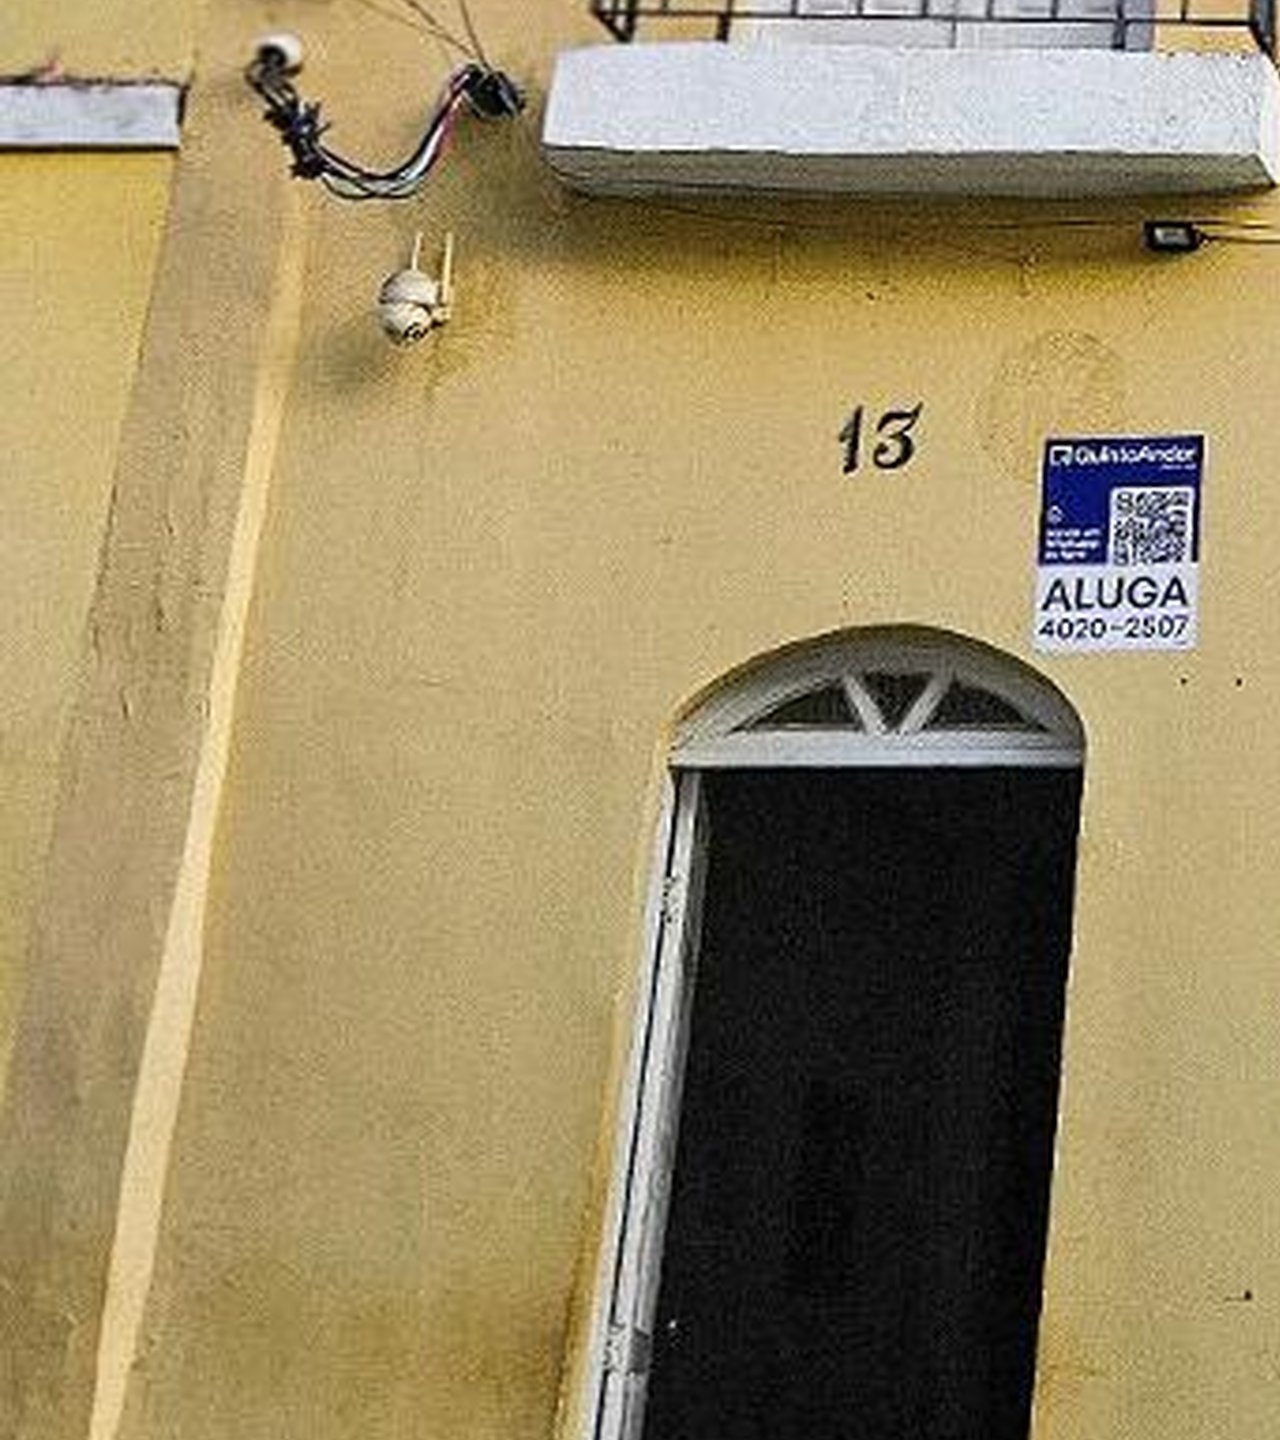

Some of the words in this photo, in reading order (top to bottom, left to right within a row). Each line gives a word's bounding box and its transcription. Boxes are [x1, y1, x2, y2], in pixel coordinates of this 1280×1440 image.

[838, 402, 924, 474] 13
[1041, 576, 1189, 611] ALUGA
[1038, 614, 1190, 640] 4020-2507
